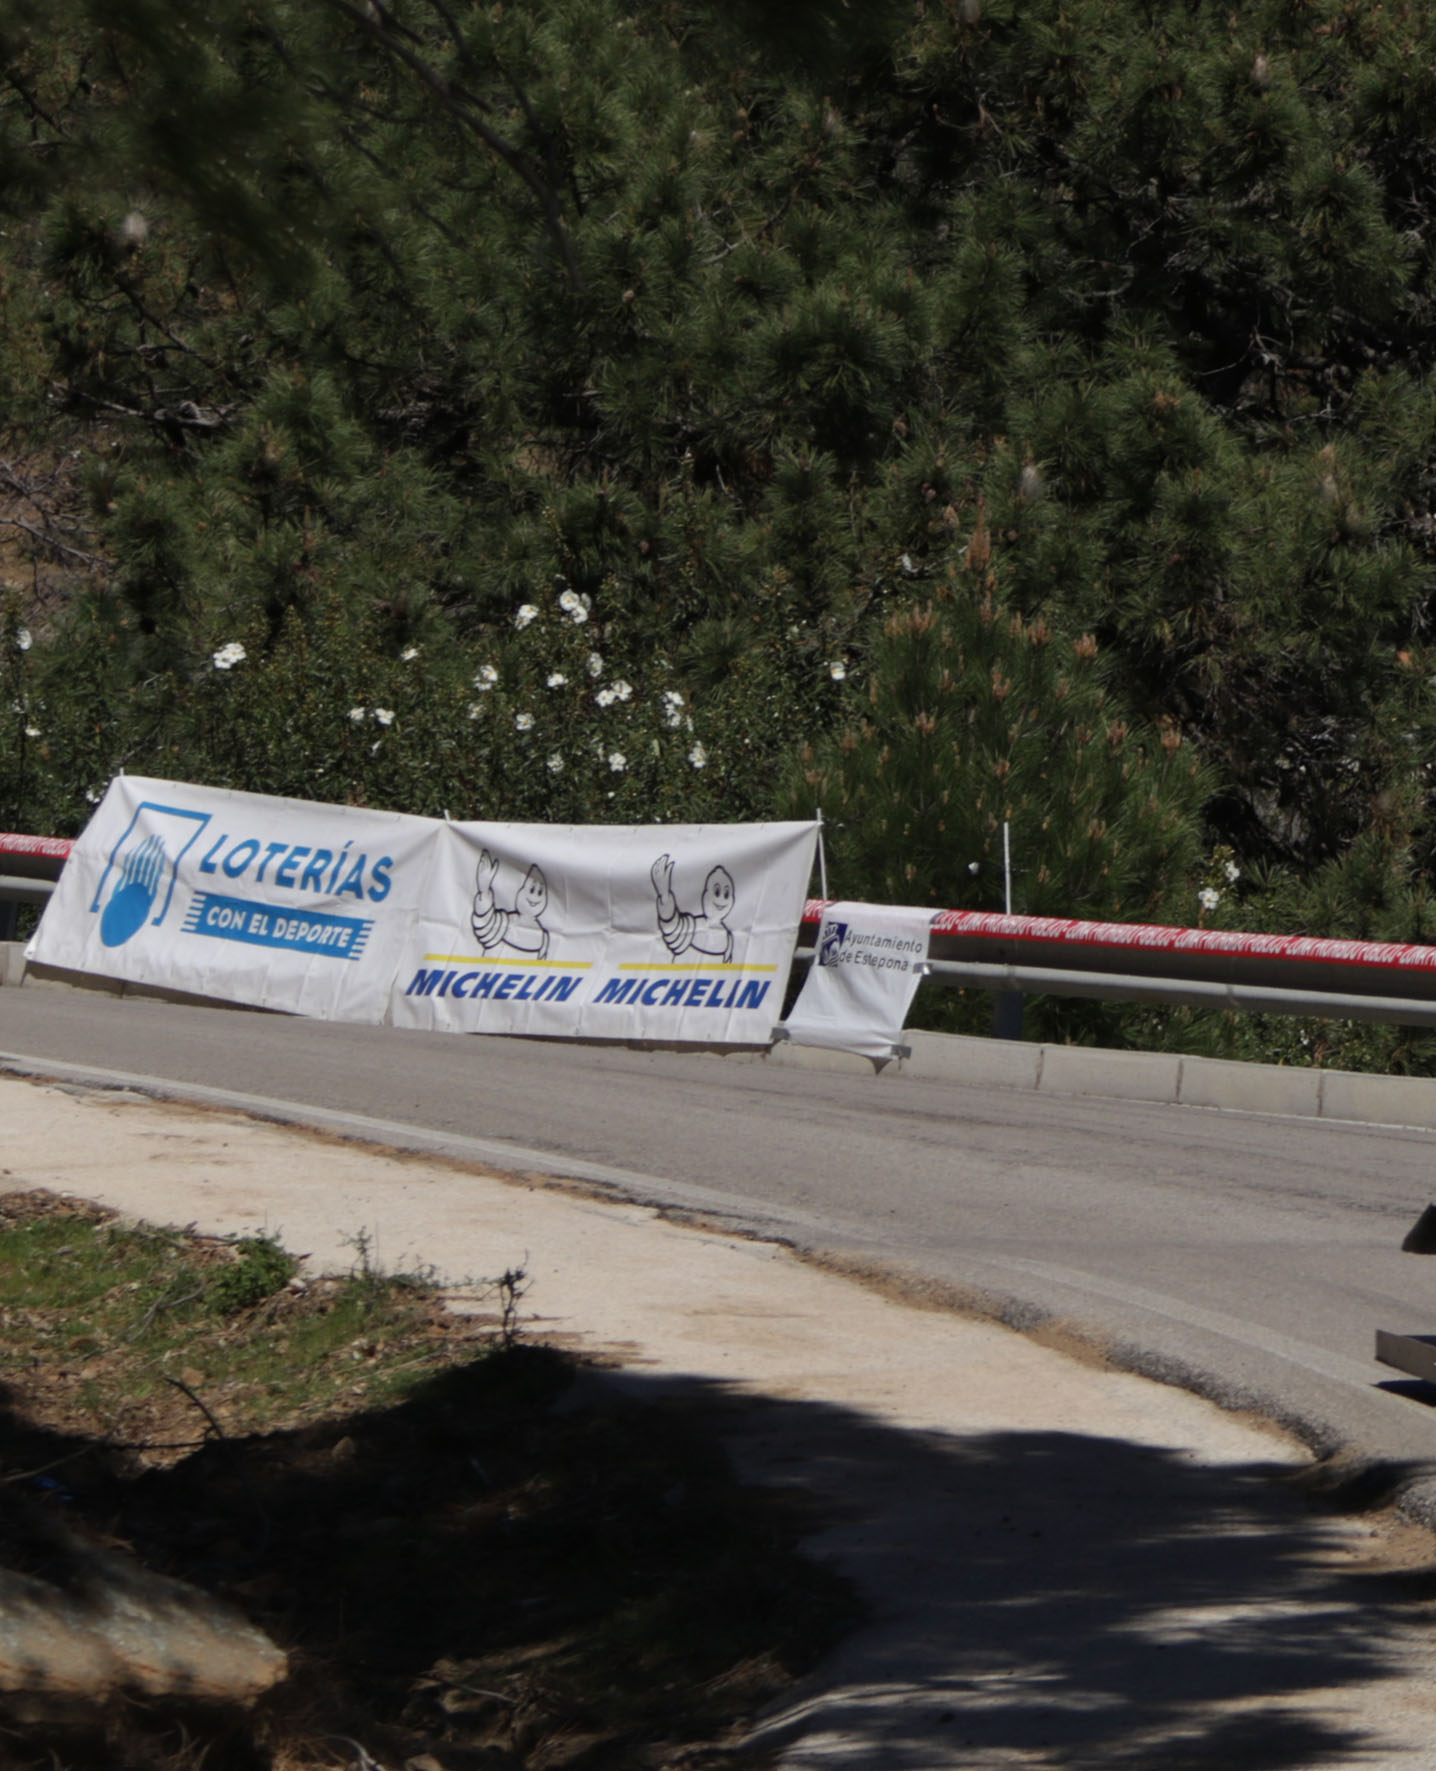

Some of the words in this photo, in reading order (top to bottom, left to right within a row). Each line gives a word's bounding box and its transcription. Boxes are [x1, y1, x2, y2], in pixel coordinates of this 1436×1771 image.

[199, 834, 394, 902] LOTERÍAS
[206, 906, 242, 930] CON
[249, 913, 270, 934] EL
[272, 916, 353, 948] DEPORTE
[845, 929, 923, 953] Ayuntamiento
[839, 950, 851, 963] de
[853, 950, 909, 971] Estepona
[405, 969, 583, 1001] MICHELIN
[593, 978, 771, 1009] MICHELIN
